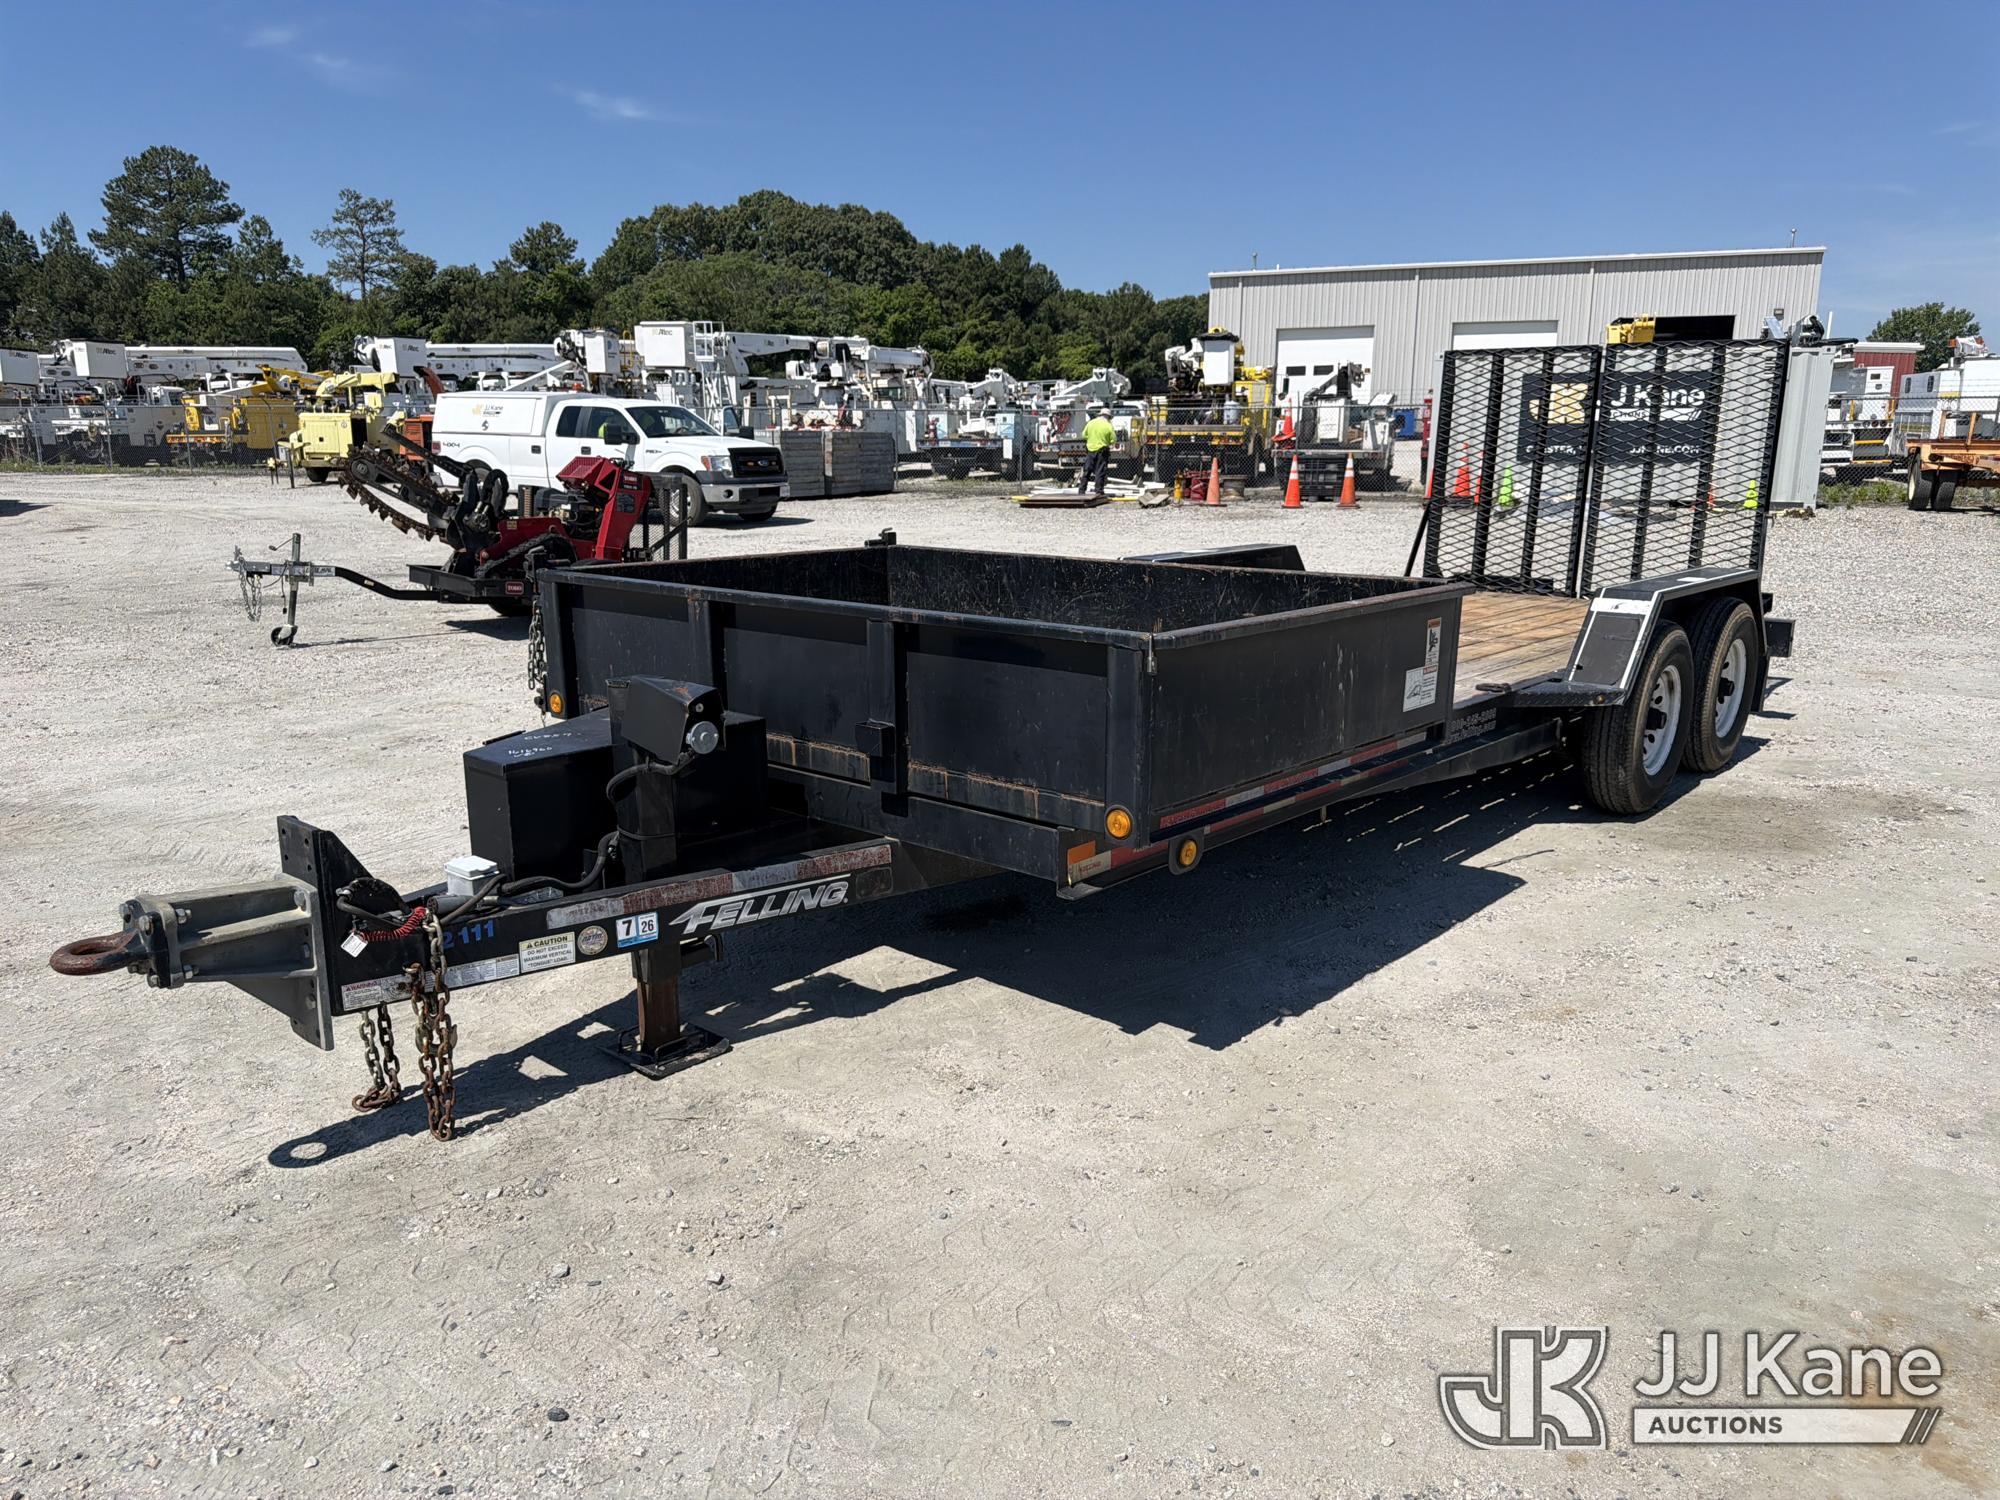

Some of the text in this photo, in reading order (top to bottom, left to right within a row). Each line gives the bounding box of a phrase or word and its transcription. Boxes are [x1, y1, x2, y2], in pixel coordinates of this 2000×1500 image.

[670, 876, 850, 934] FELLING
[622, 919, 654, 936] 7 26
[534, 936, 568, 947] CAUTION
[548, 944, 567, 952] EXCEED
[524, 949, 572, 962] MAXIMUM VERTICAL
